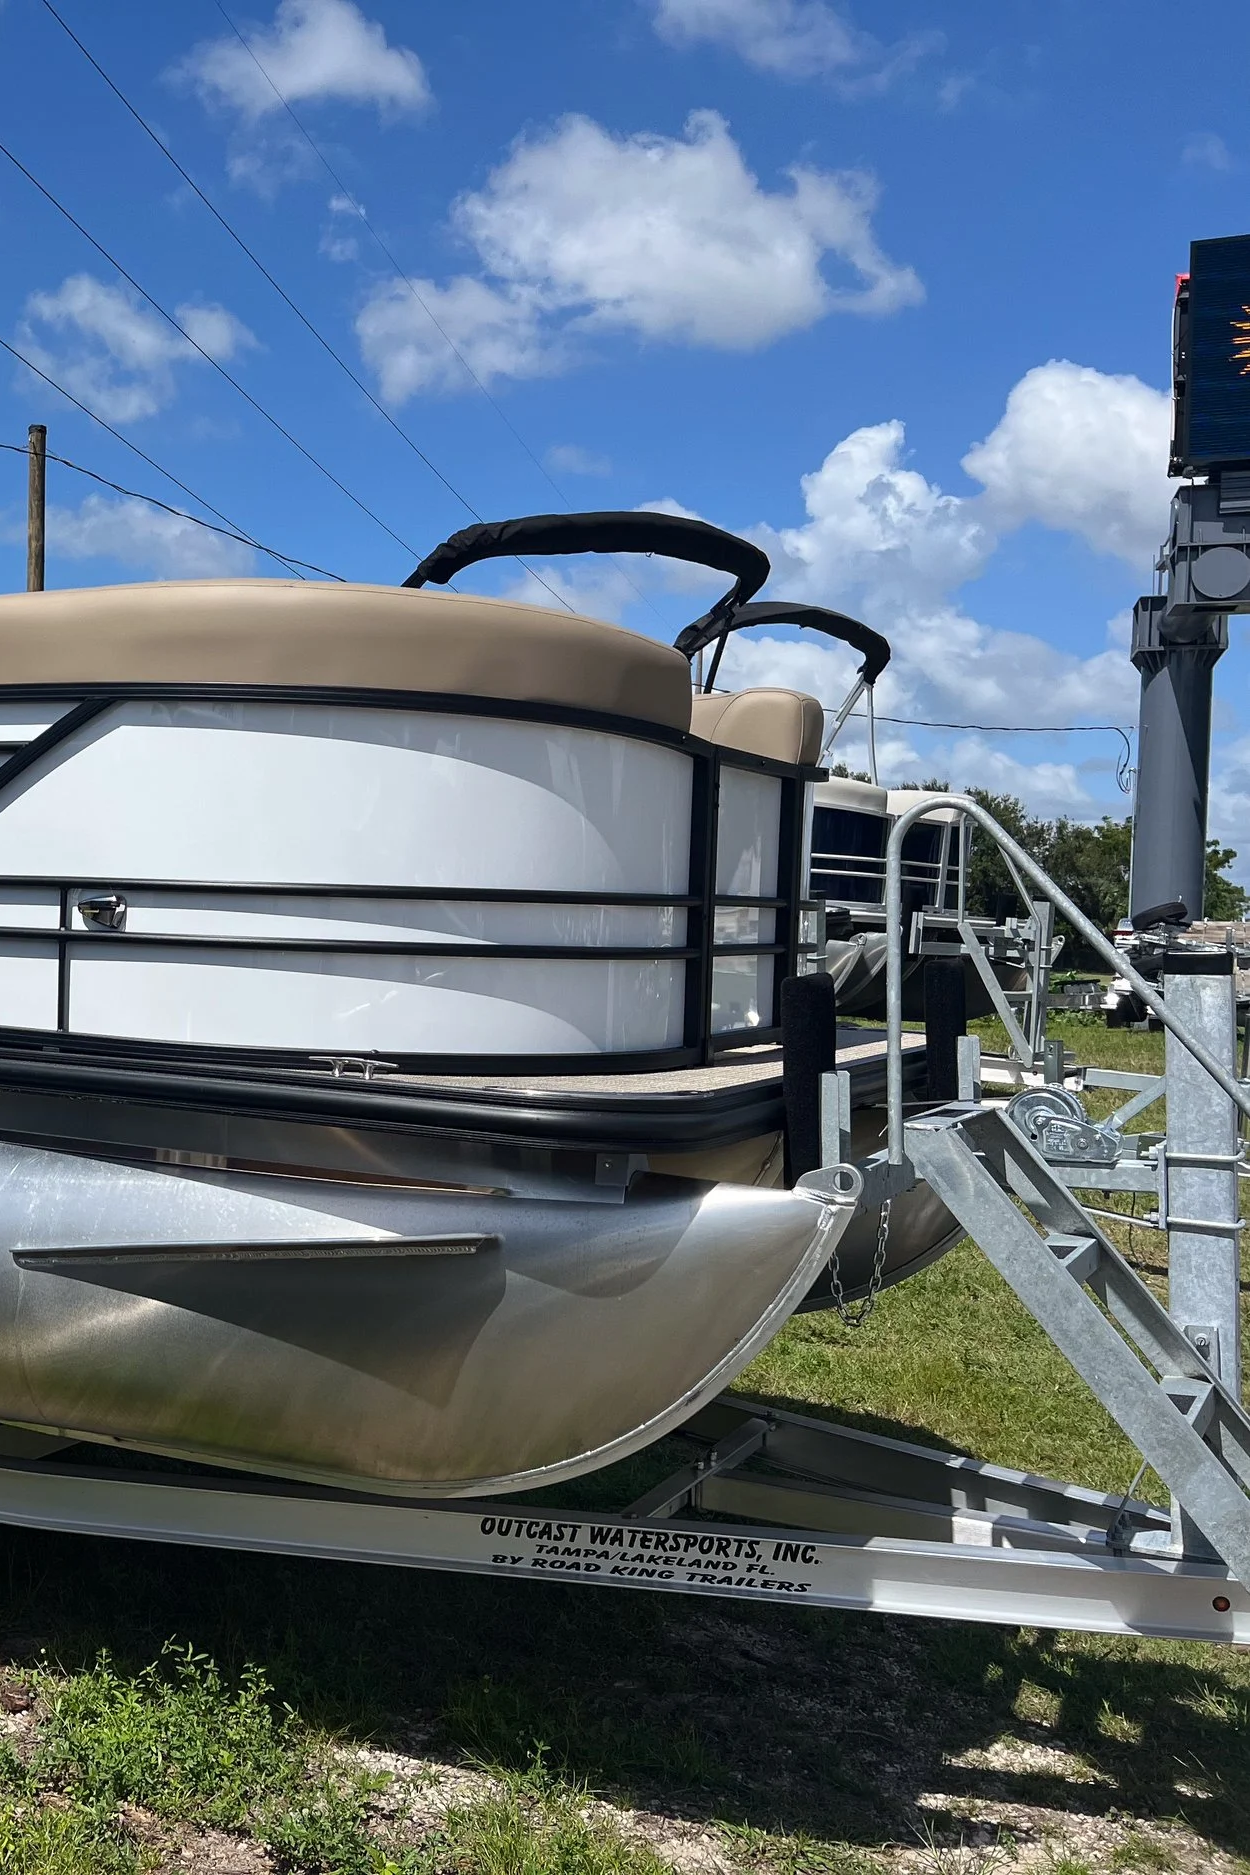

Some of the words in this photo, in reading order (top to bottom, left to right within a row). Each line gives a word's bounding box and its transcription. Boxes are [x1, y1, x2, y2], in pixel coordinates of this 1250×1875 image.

[480, 1517, 582, 1543] OUTCAST
[589, 1525, 763, 1563] WATERSPORTS,
[772, 1541, 820, 1565] INC.
[535, 1544, 738, 1571] TAMPA/LAKELAND
[745, 1563, 775, 1576] FL.
[491, 1554, 524, 1565] BY
[531, 1558, 601, 1573] ROAD
[609, 1565, 675, 1580] KING
[685, 1572, 812, 1593] TRAILERS
